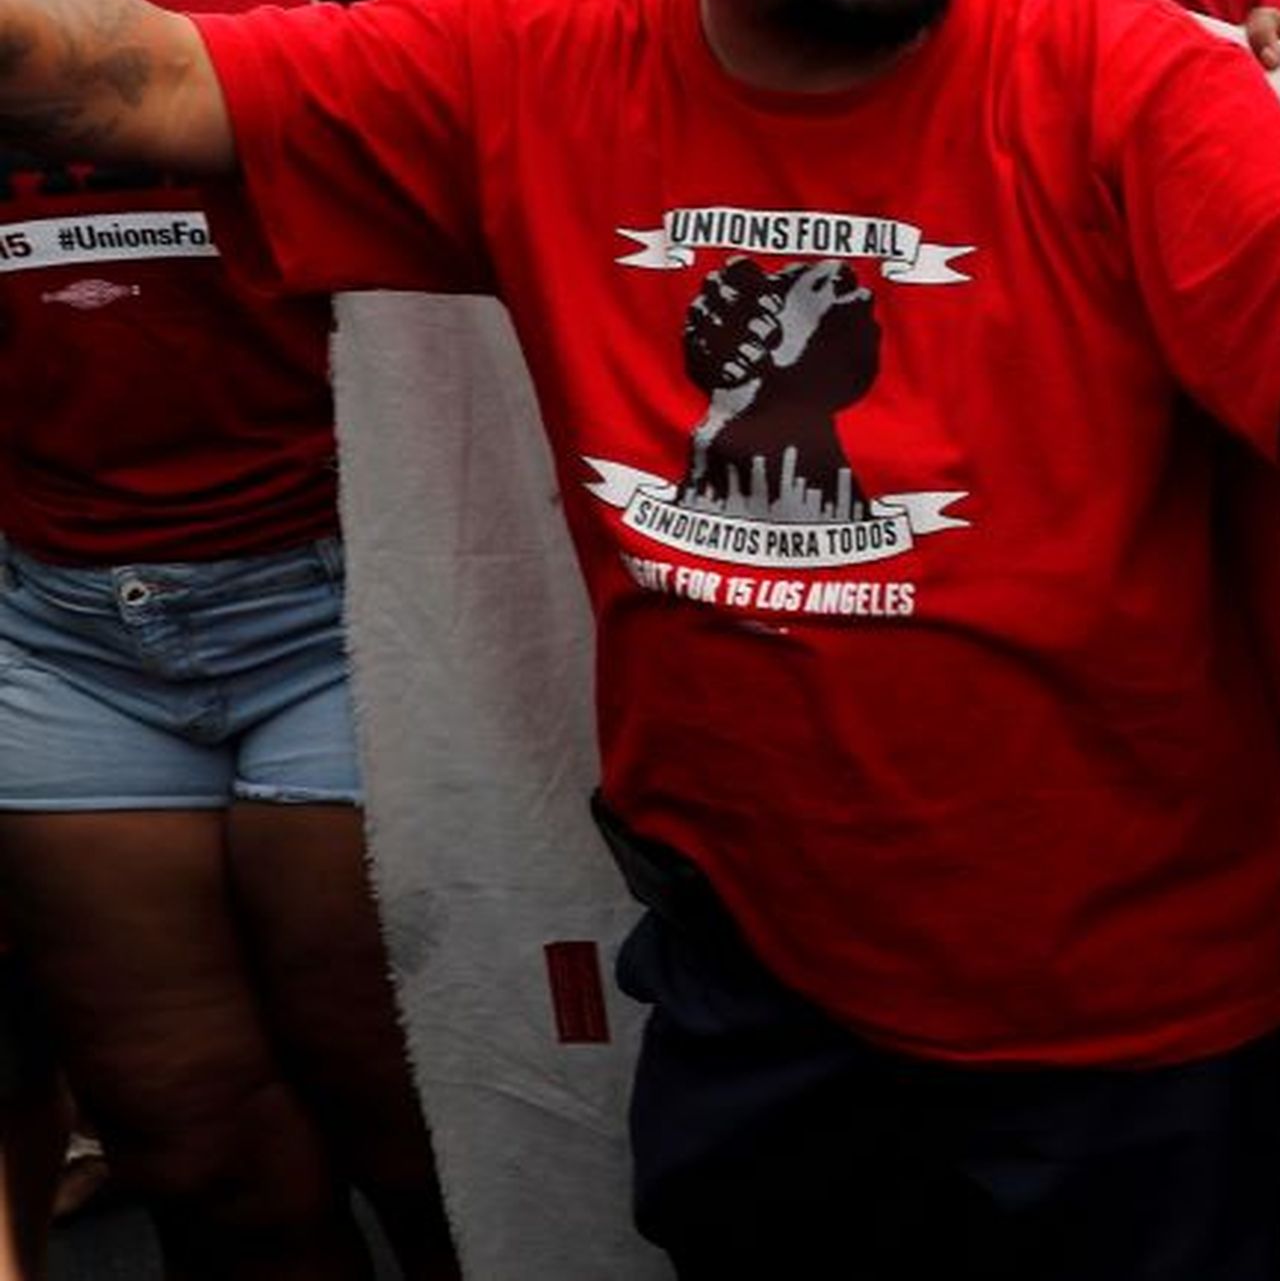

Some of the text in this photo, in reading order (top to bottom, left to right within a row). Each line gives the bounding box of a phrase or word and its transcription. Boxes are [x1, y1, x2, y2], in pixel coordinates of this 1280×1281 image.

[58, 221, 214, 251] #UnionsFo
[670, 211, 904, 257] UNIONS FOR ALL
[634, 500, 897, 558] SINDICATOS PARA TODOS
[674, 572, 718, 603] FOR
[726, 578, 754, 606] 15
[756, 582, 800, 611] LOS
[804, 582, 916, 617] ANGELES
